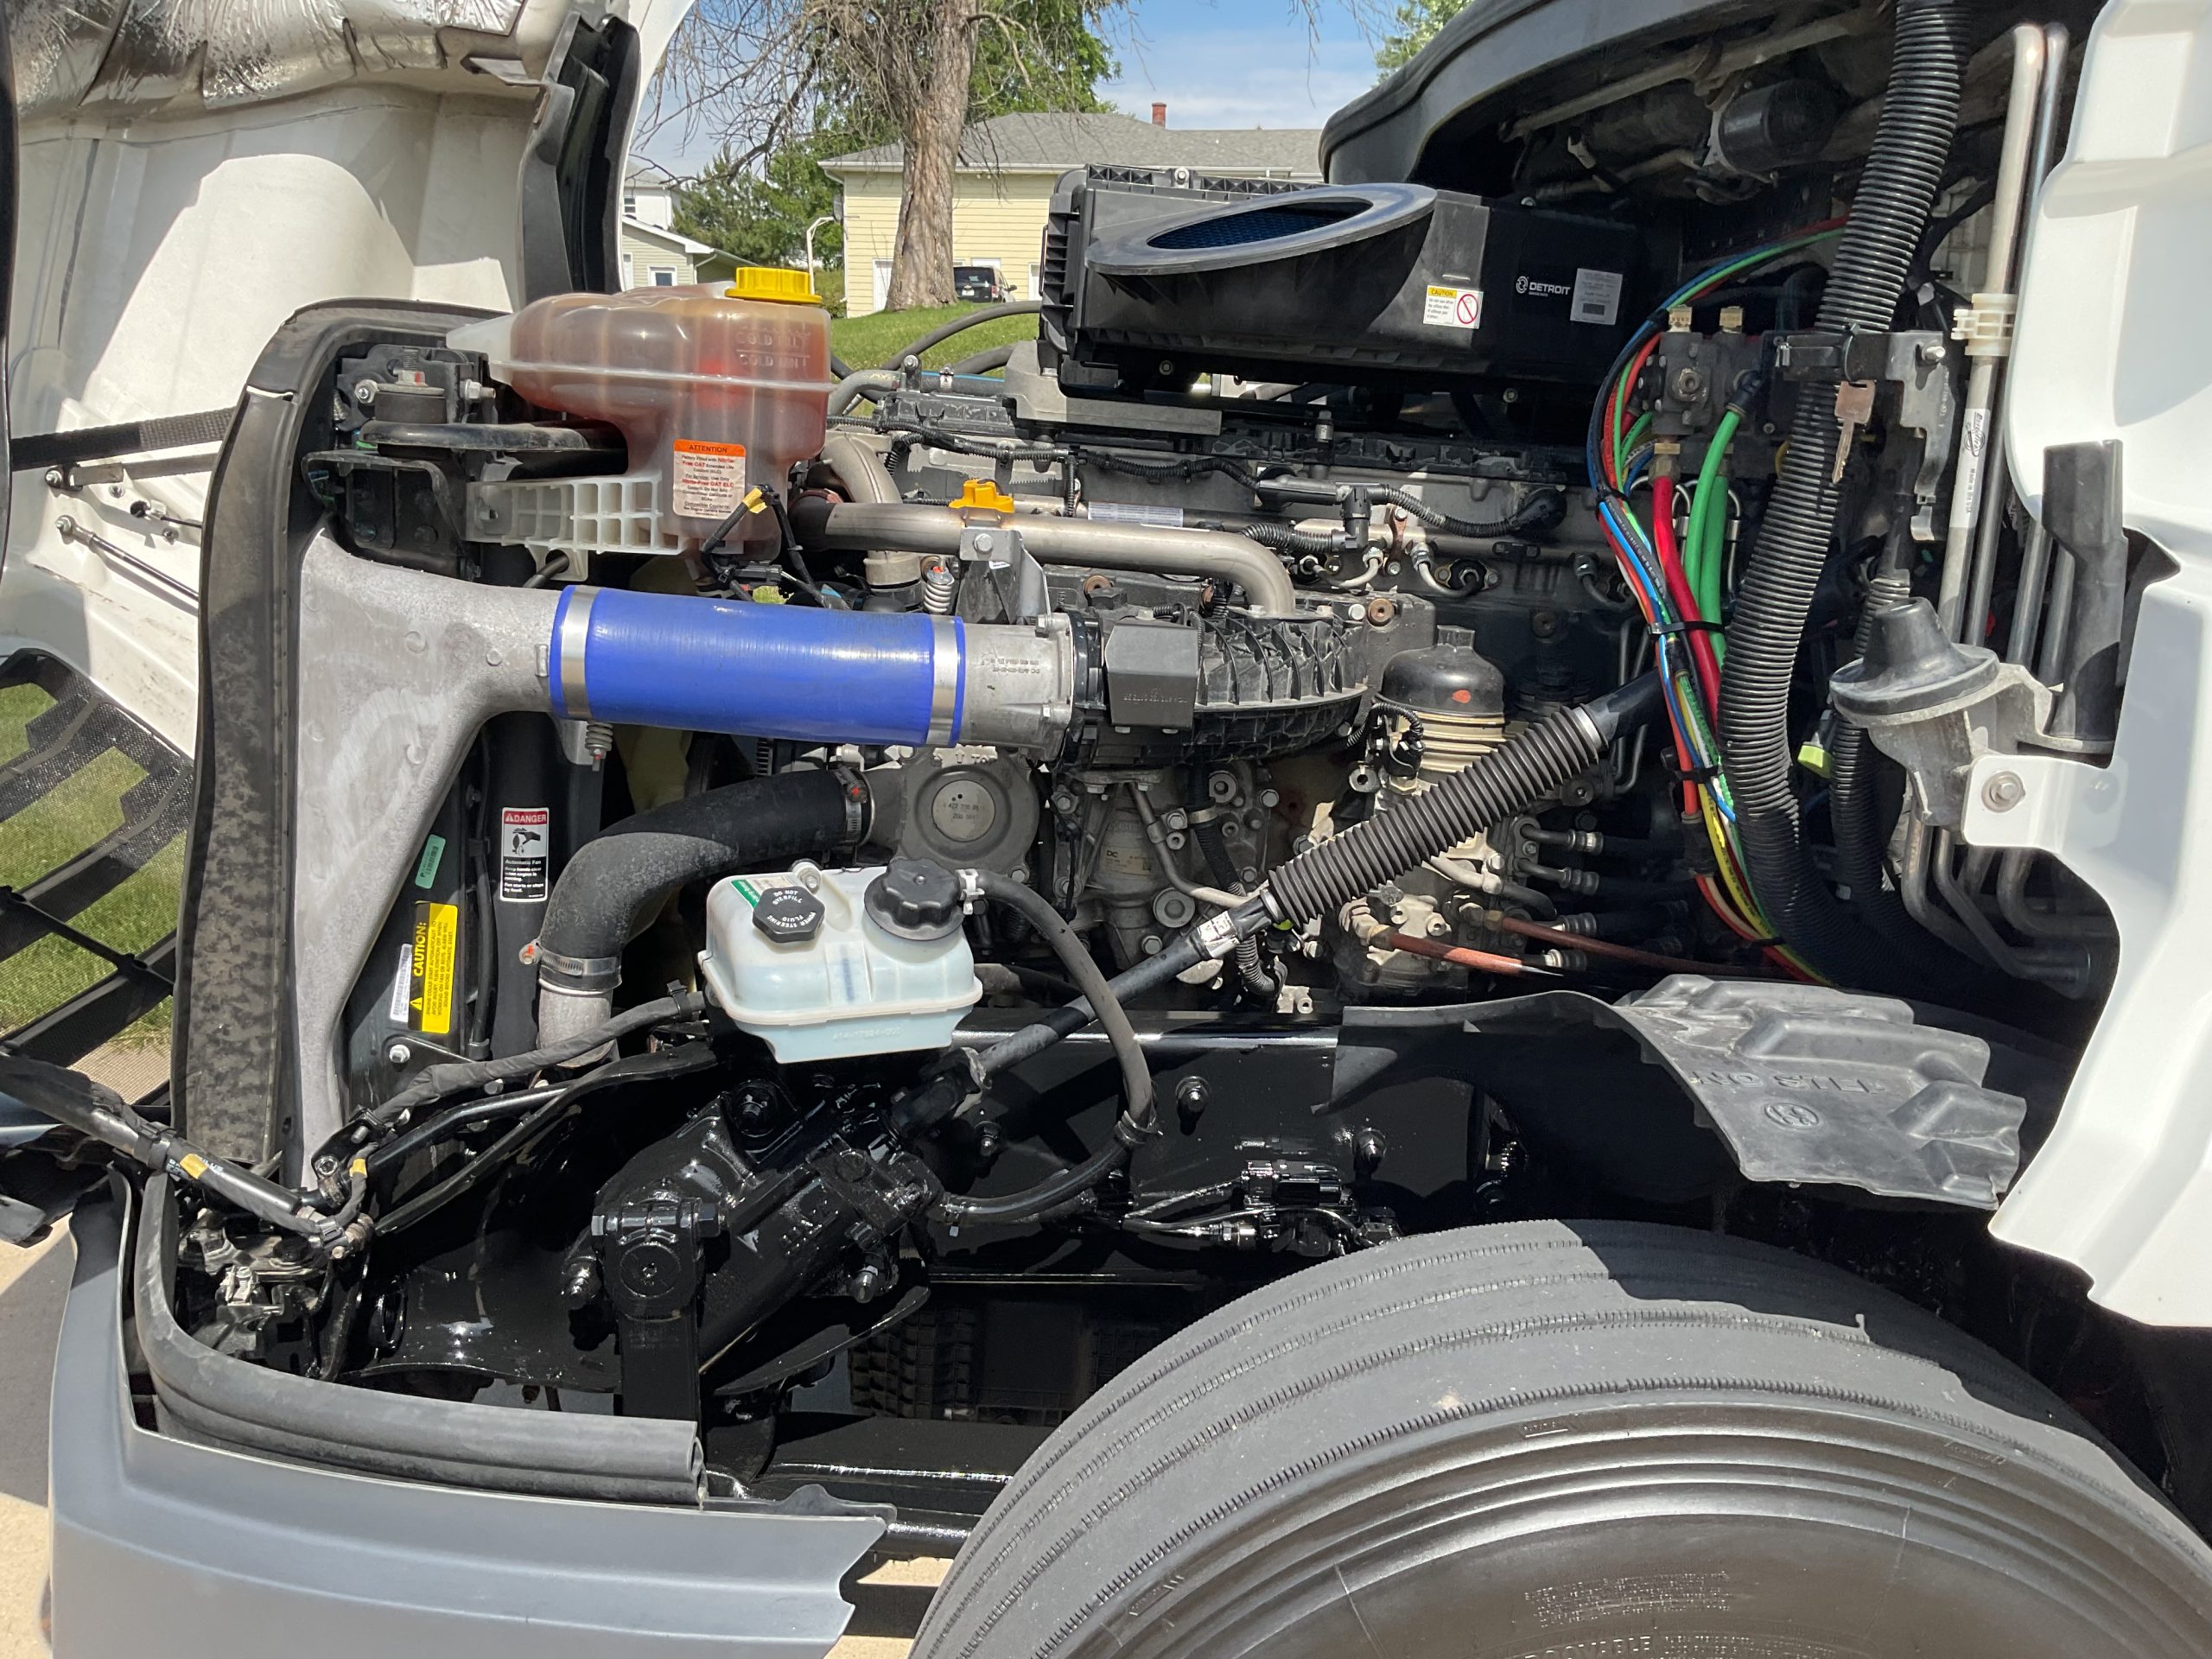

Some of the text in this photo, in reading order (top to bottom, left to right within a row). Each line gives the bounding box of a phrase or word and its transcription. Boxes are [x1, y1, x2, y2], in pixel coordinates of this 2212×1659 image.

[1529, 282, 1571, 295] DETROIT
[740, 354, 773, 366] COLD
[514, 814, 546, 823] DANGER
[767, 912, 816, 927] POWER STEERING
[413, 922, 426, 977] CAUTION:
[1692, 1071, 1764, 1088] NO
